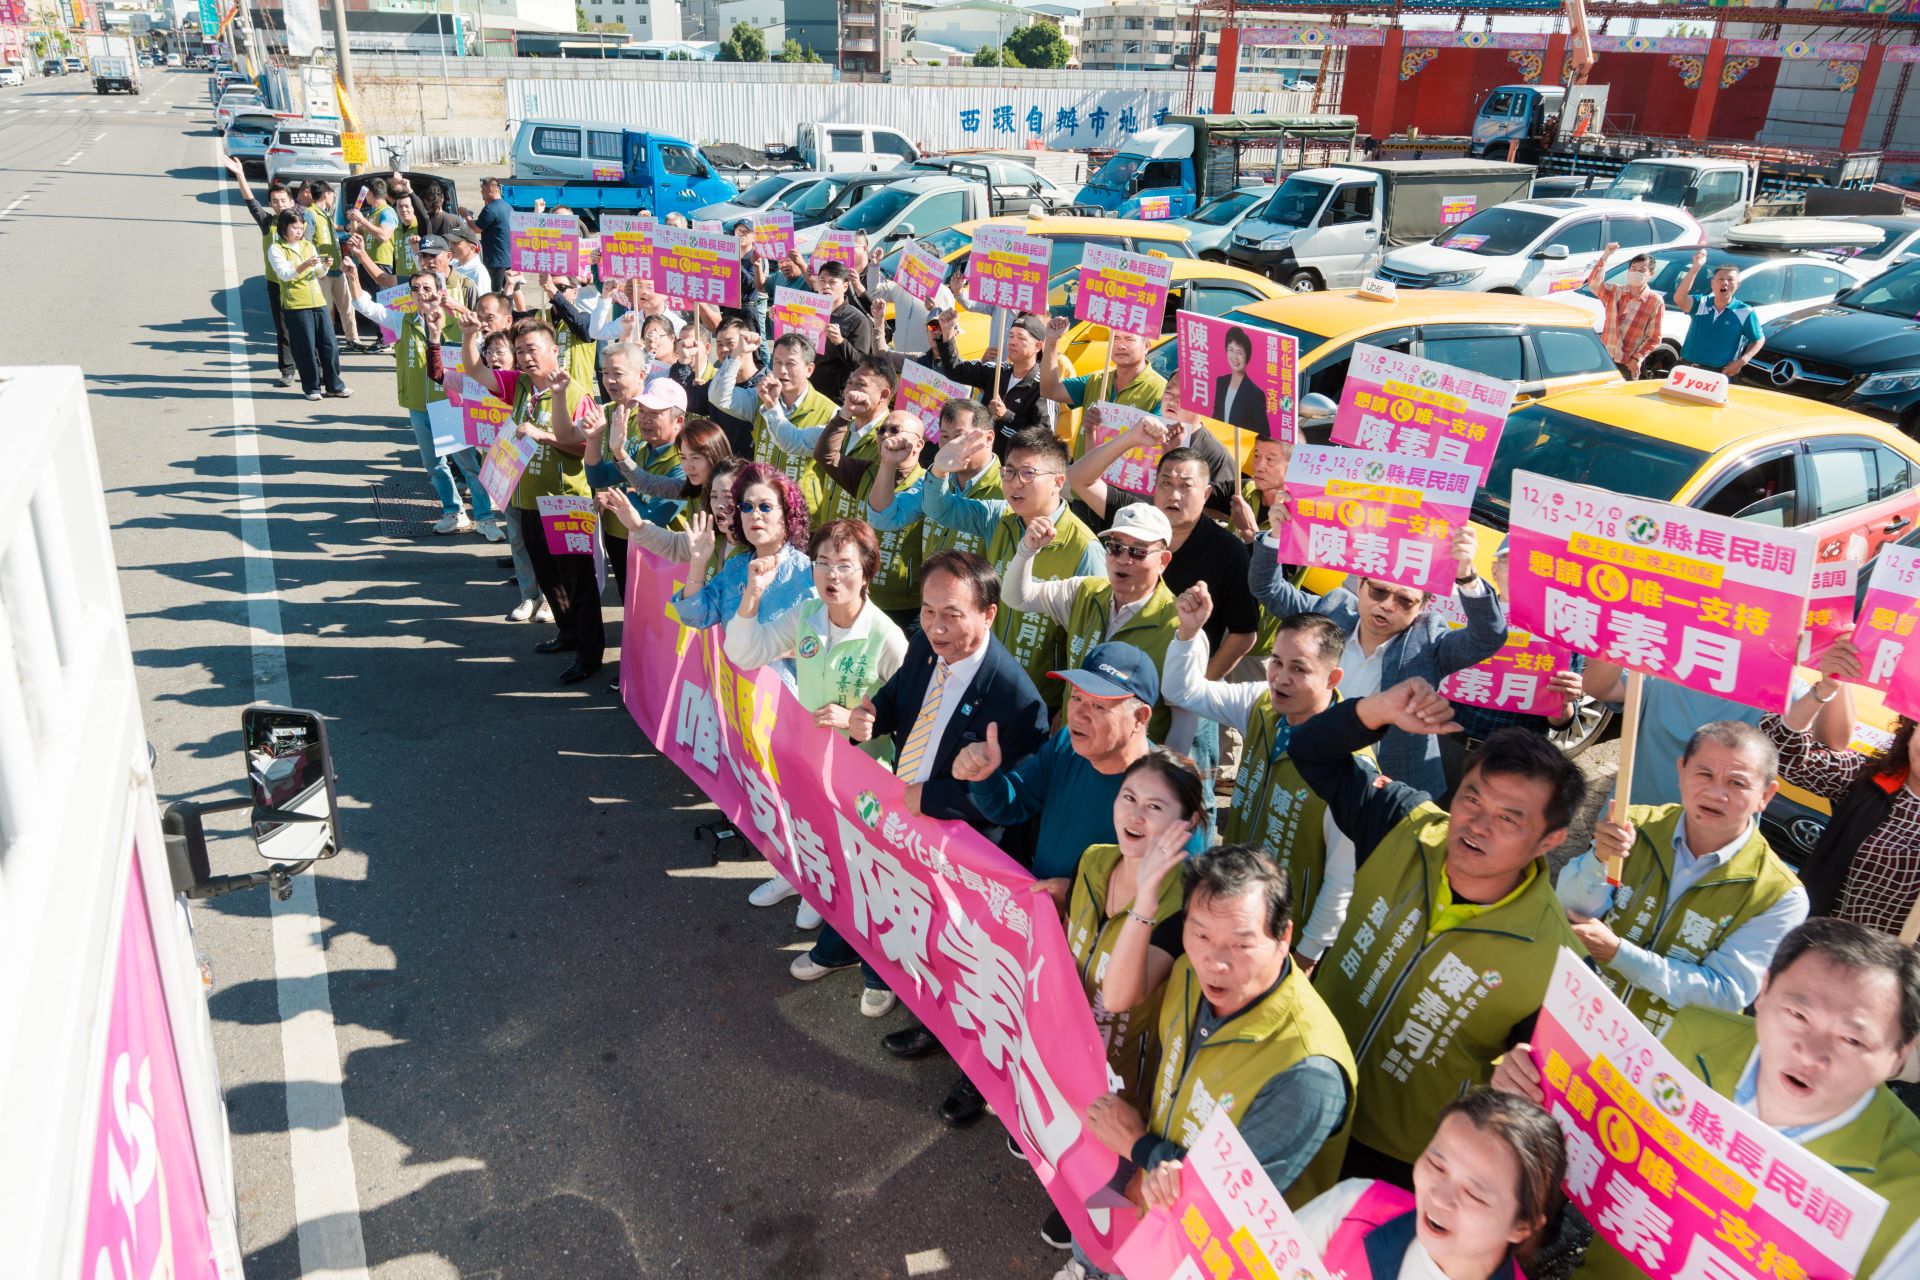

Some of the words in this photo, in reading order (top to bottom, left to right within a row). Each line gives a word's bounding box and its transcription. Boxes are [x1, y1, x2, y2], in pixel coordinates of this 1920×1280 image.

[521, 251, 568, 273] 陳素月
[611, 256, 651, 279] 陳素月
[691, 261, 731, 278] 唯一支持
[665, 270, 725, 304] 陳素月
[980, 276, 1034, 311] 陳素月
[1116, 285, 1157, 306] 唯一支持
[1366, 282, 1384, 293] Uber
[1086, 294, 1148, 334] 陳素月
[1187, 320, 1209, 407] 陳素月
[1438, 373, 1508, 408] 縣長民調
[1684, 378, 1720, 393] yoxi
[1354, 391, 1389, 414] 懇請
[1414, 407, 1488, 442] 唯一支持
[1354, 413, 1470, 464] 陳素月
[1386, 463, 1470, 495] 縣長民調
[1297, 499, 1335, 521] 懇請
[1367, 507, 1450, 540] 唯一支持
[565, 533, 592, 552] 陳
[1307, 522, 1433, 587] 陳素月
[1661, 520, 1797, 576] 縣長民調
[1528, 550, 1583, 588] 懇請
[1630, 577, 1772, 637] 唯一支持
[1543, 586, 1742, 694] 陳素月
[1868, 607, 1918, 637] 懇請
[835, 655, 854, 707] 陳素月
[1438, 668, 1538, 711] 素月
[882, 811, 1045, 1003] 彰化縣長擬參人
[1393, 951, 1480, 1060] 陳素月
[1543, 1048, 1599, 1122] 懇請
[1637, 1146, 1808, 1280] 唯一支持
[1685, 1100, 1855, 1240] 縣長民調
